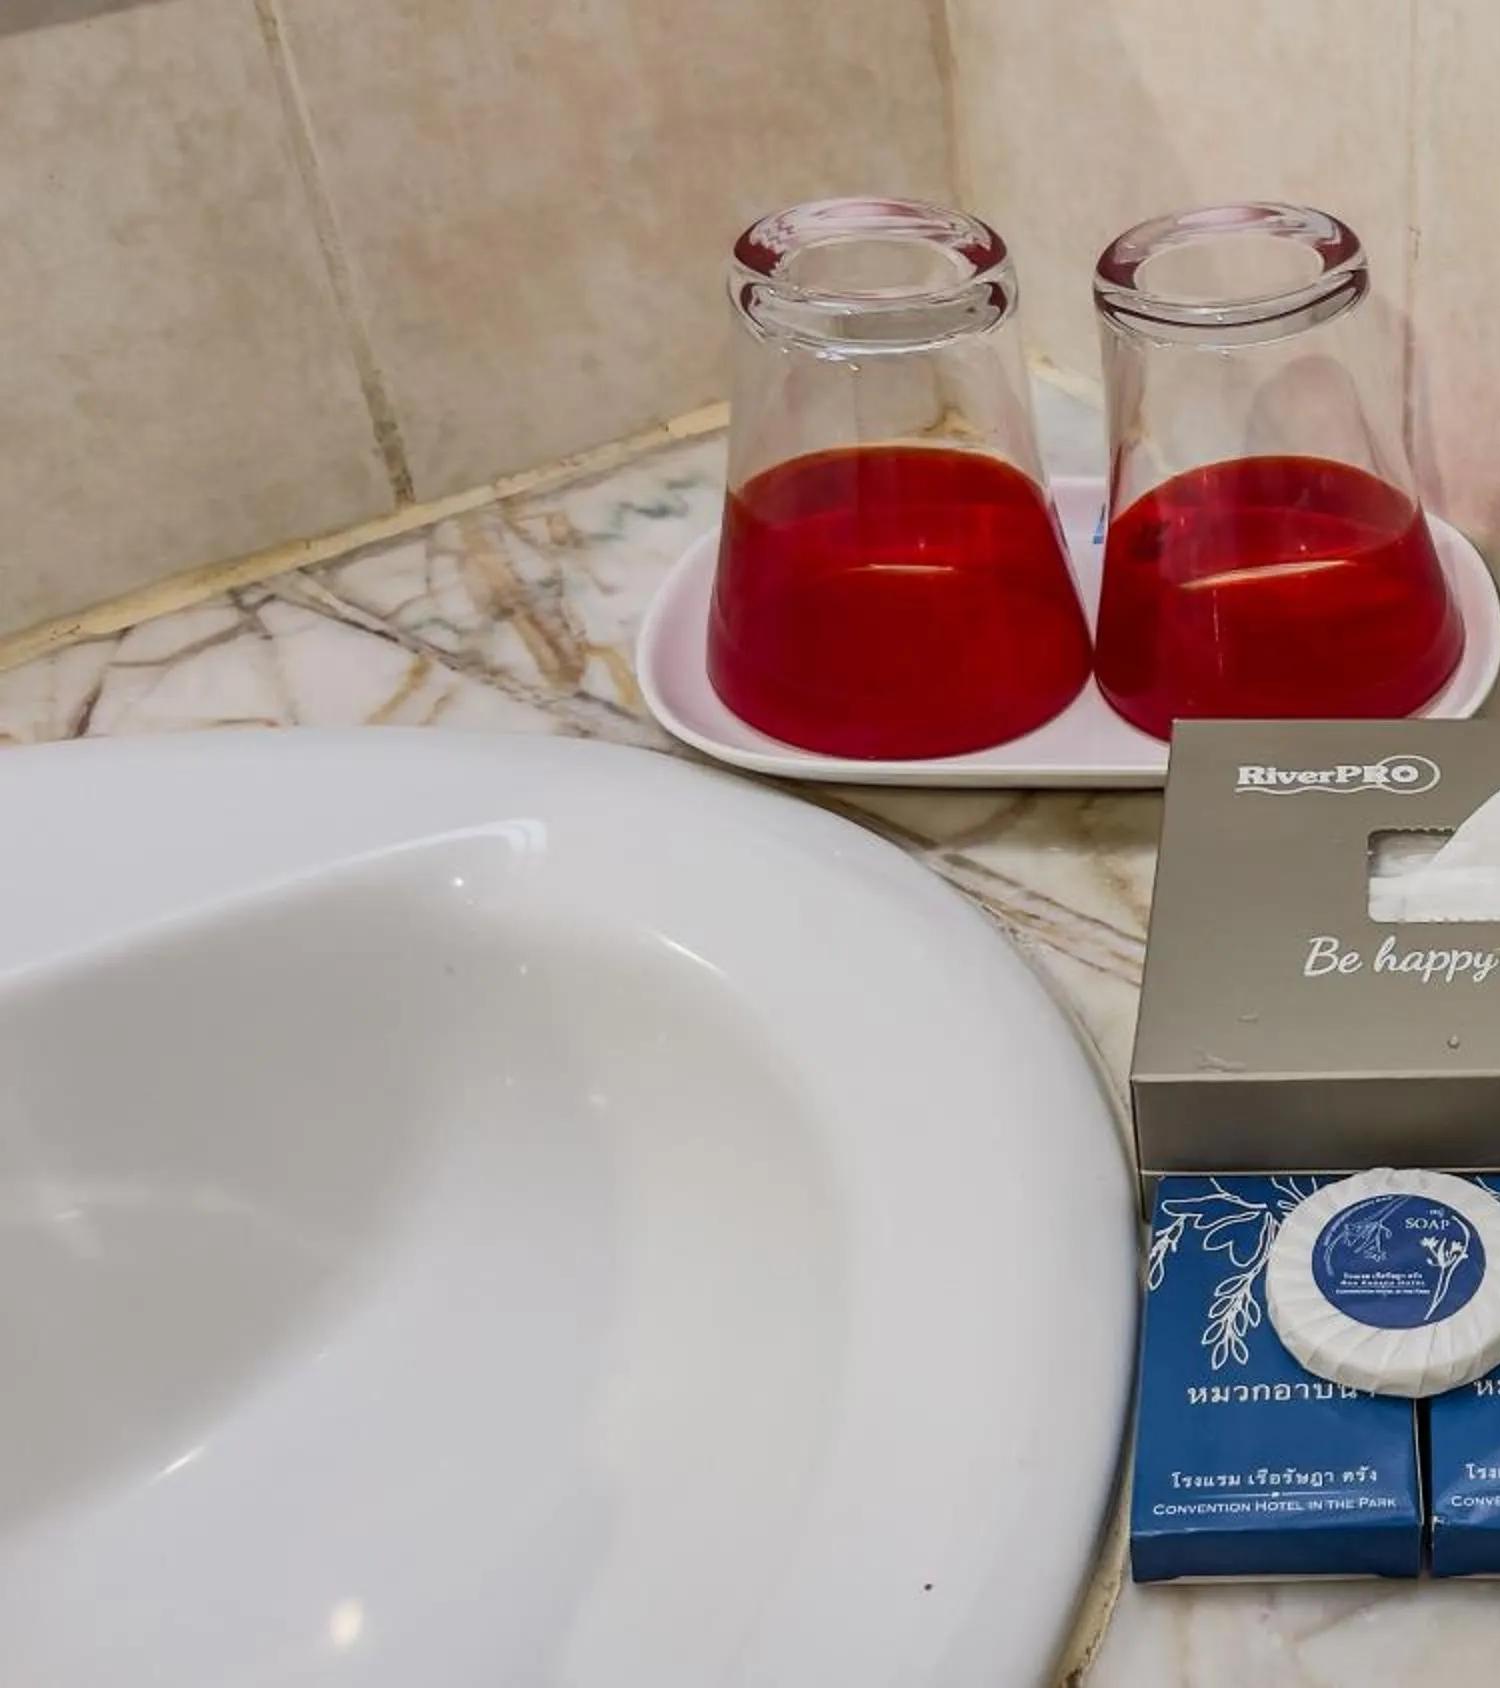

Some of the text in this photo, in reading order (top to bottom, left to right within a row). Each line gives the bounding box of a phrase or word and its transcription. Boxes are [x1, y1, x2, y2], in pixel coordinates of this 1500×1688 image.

[1236, 764, 1419, 785] RiverPRO
[1304, 936, 1362, 977] Be
[1373, 936, 1498, 982] happy
[1405, 1217, 1449, 1230] SOAP
[1187, 1382, 1375, 1405] หมวกอาบน
